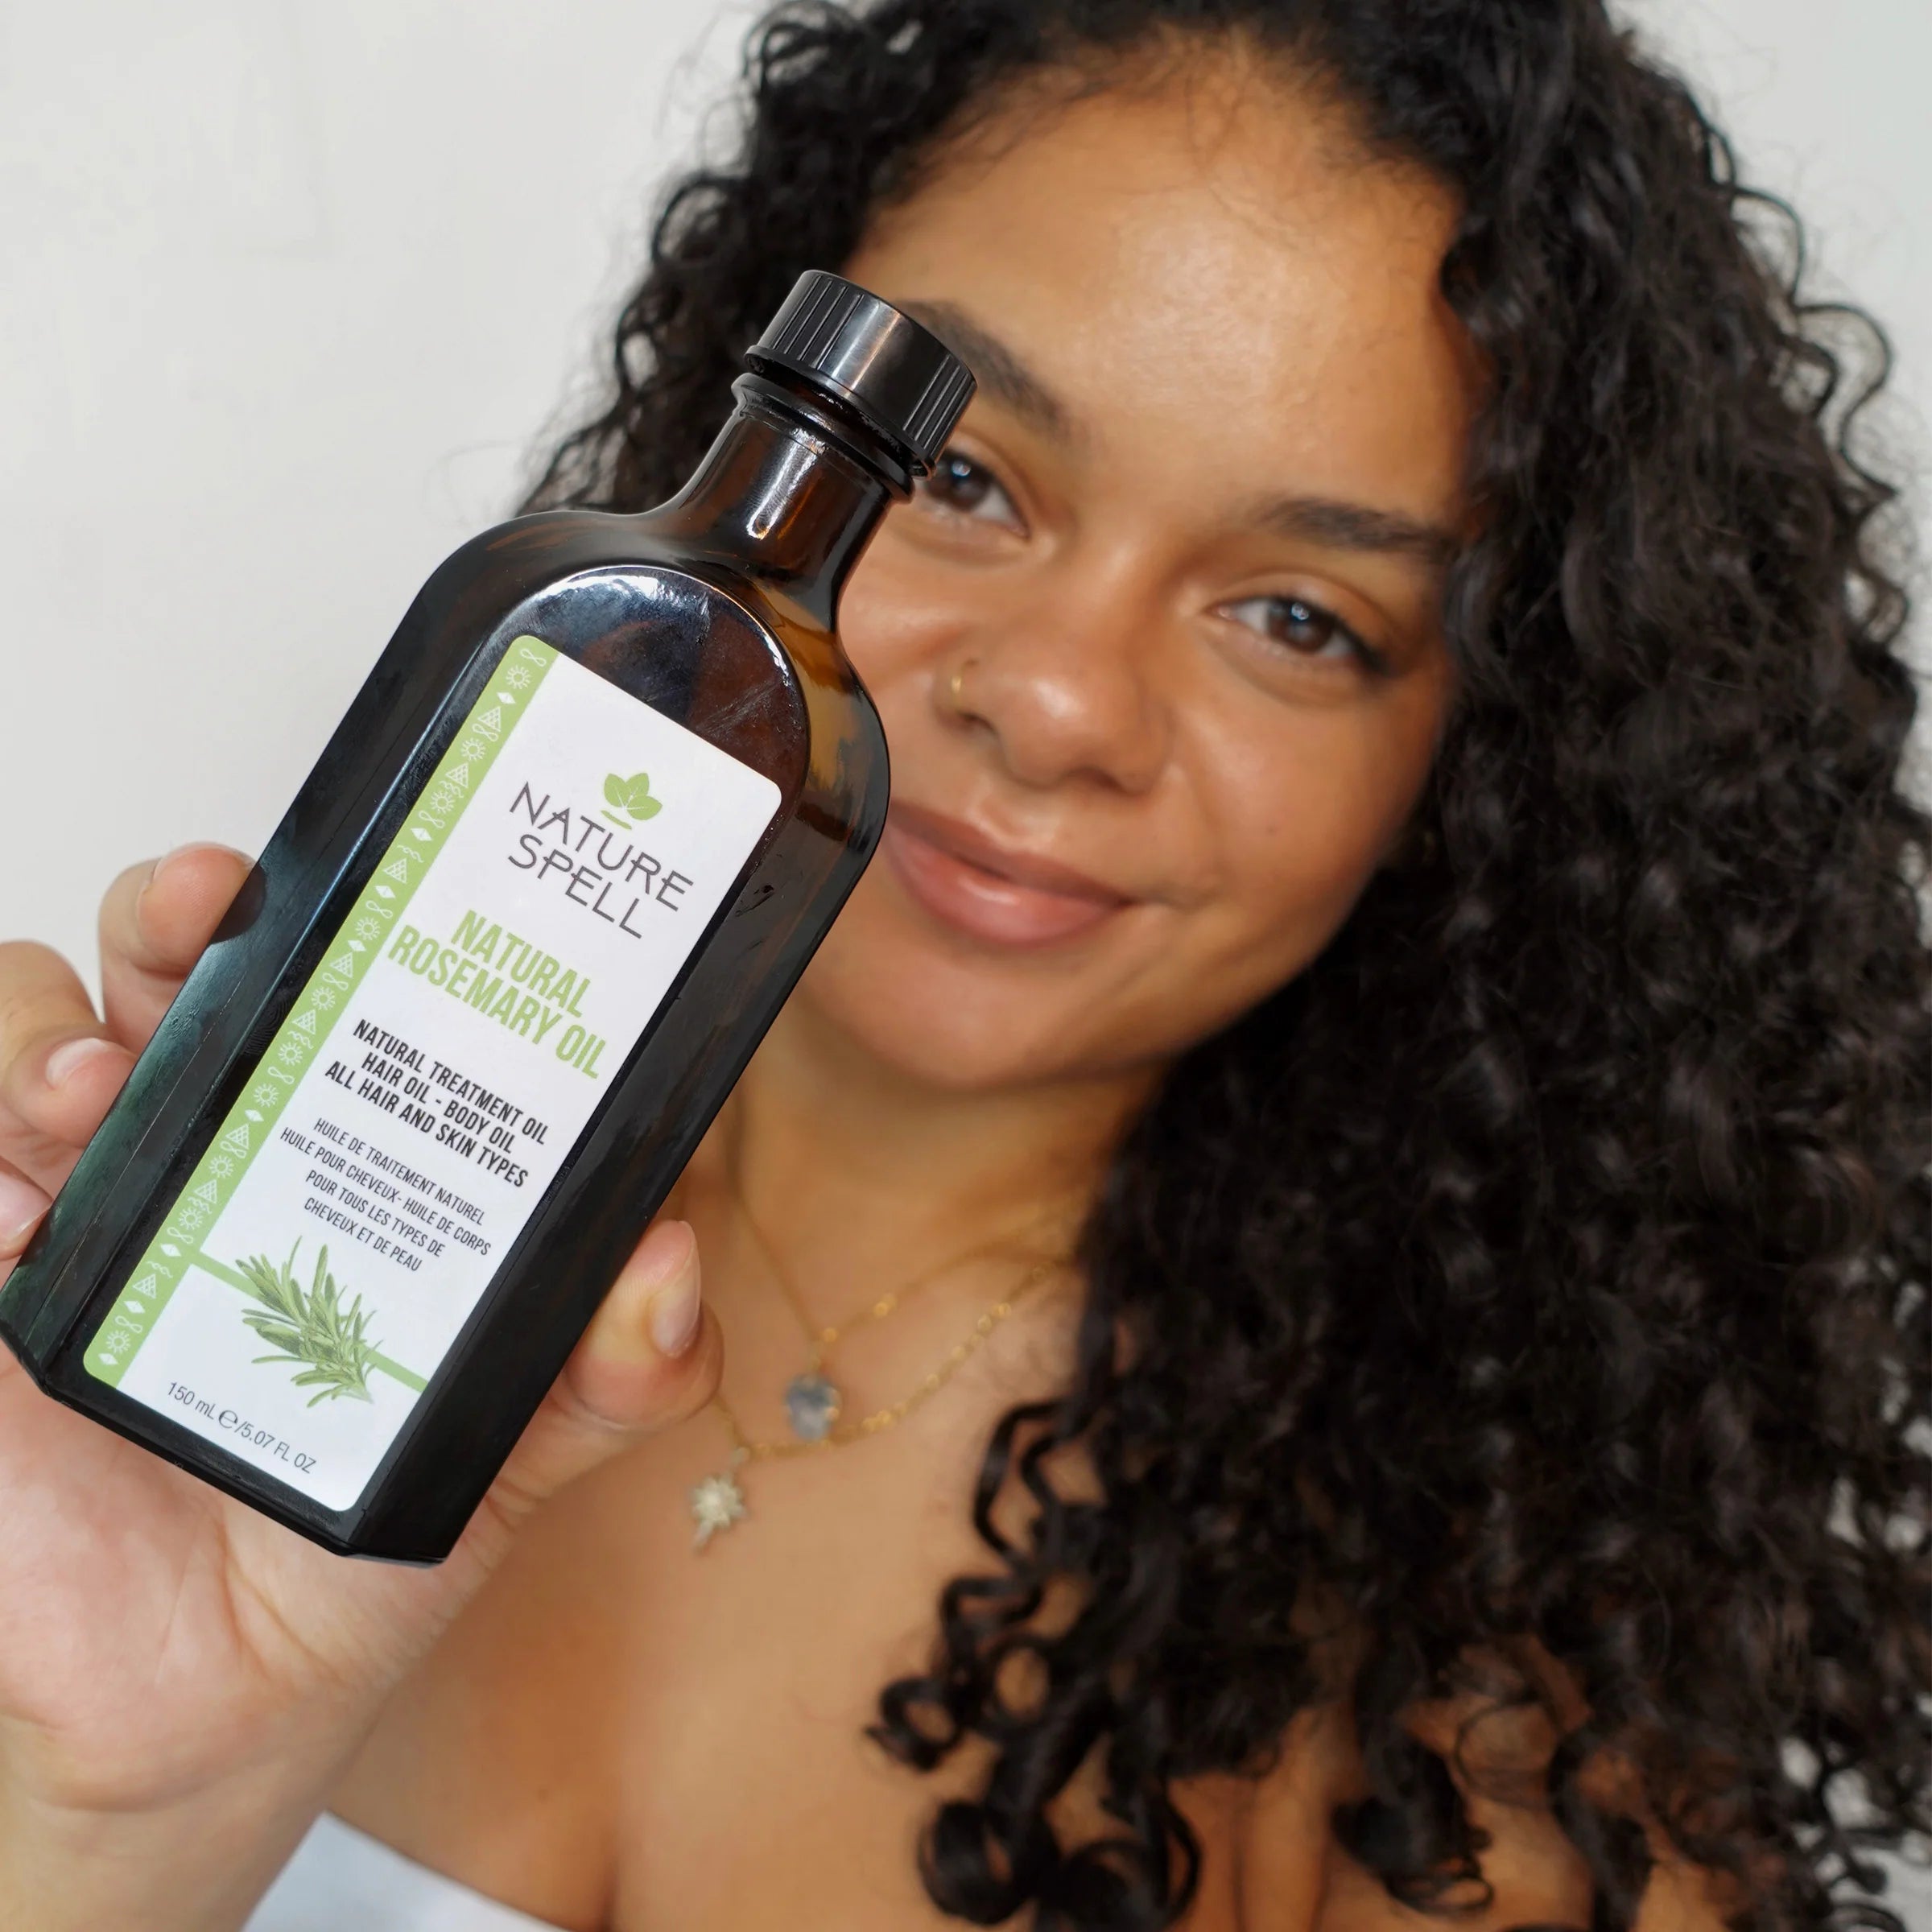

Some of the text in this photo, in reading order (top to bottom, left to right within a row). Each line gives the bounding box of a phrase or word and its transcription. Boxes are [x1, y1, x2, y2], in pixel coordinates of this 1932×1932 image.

[508, 834, 642, 939] SPELL
[510, 781, 693, 911] NATURE
[388, 925, 606, 1079] ROSEMARY OIL
[451, 910, 590, 1018] NATURAL
[324, 1060, 529, 1187] ALL HAIR AND SKIN TYPES
[353, 1019, 548, 1145] NATURAL TREATMENT OIL
[361, 1051, 403, 1087] HAIR
[403, 1076, 431, 1104] OIL
[444, 1100, 490, 1135] BODY
[489, 1126, 515, 1154] OIL
[280, 1127, 316, 1155] HUILE
[314, 1146, 346, 1173] POUR
[403, 1197, 438, 1225] HUILE
[436, 1216, 455, 1235] DE
[453, 1227, 491, 1256] CORPS
[306, 1170, 446, 1257] POUR TOUS LES TYPES DE
[314, 1117, 485, 1225] HUILE DE TRAITEMENT NATUREL
[304, 1197, 423, 1272] CHEVEUX ET DE PEAU
[167, 1381, 195, 1406] 150
[274, 1441, 291, 1462] FL
[294, 1453, 316, 1474] OZ
